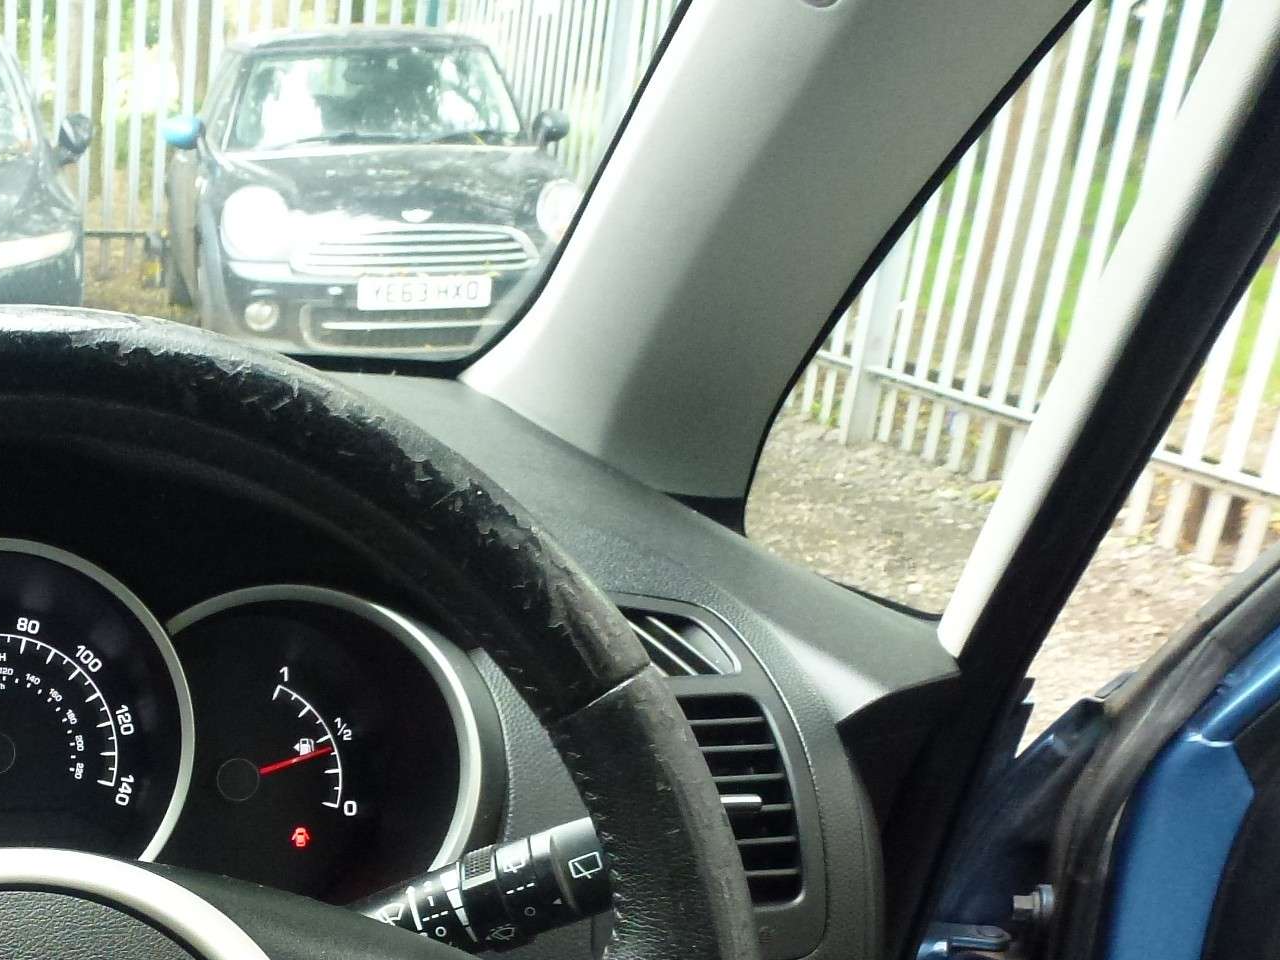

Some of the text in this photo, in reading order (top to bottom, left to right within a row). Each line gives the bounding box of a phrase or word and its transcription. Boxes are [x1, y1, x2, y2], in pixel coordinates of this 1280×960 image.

[16, 617, 40, 634] 80
[75, 644, 103, 674] 100
[278, 666, 290, 682] 1
[115, 704, 134, 736] 120
[115, 774, 135, 807] 140
[343, 800, 357, 816] 0
